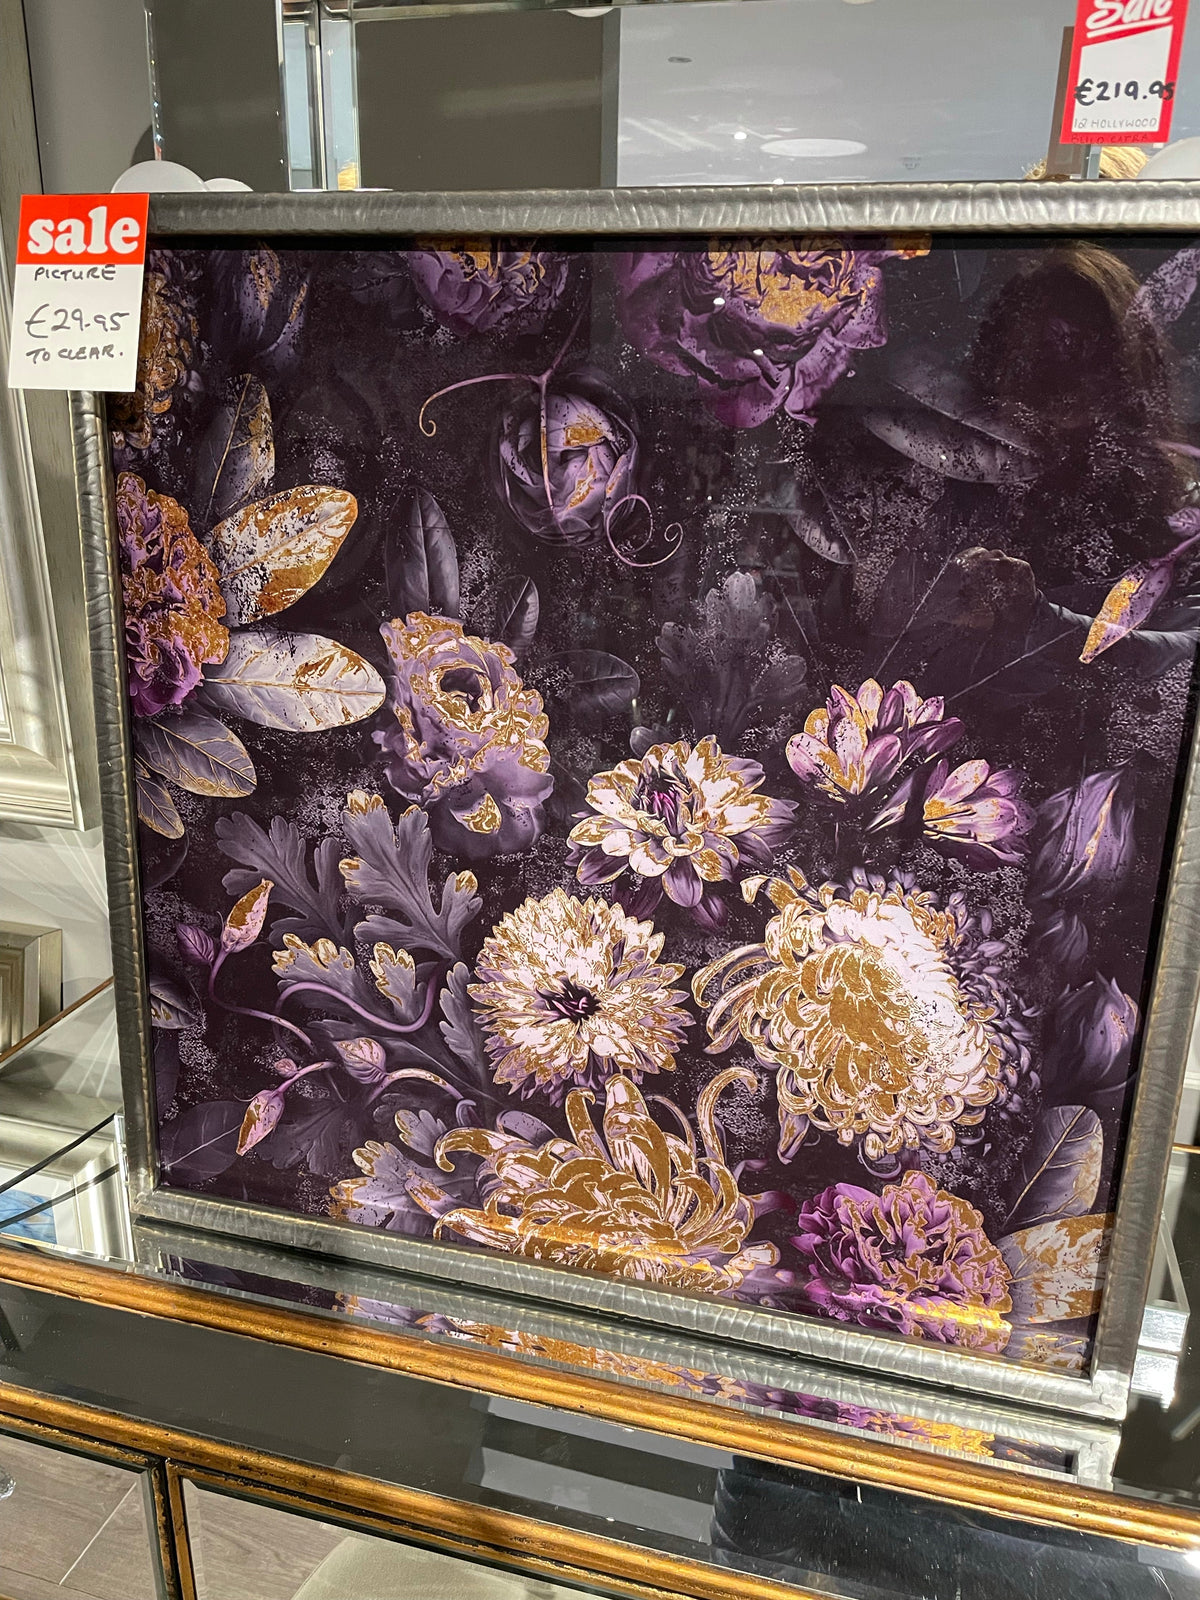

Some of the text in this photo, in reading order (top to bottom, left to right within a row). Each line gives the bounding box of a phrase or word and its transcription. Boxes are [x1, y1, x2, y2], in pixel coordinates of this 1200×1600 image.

[1073, 78, 1175, 107] €219.95
[1091, 117, 1158, 129] HOLLYWOOD
[27, 206, 141, 255] sale
[34, 264, 117, 282] PICTURE
[25, 303, 130, 338] €29.95
[26, 344, 124, 364] TO CLEAR.
